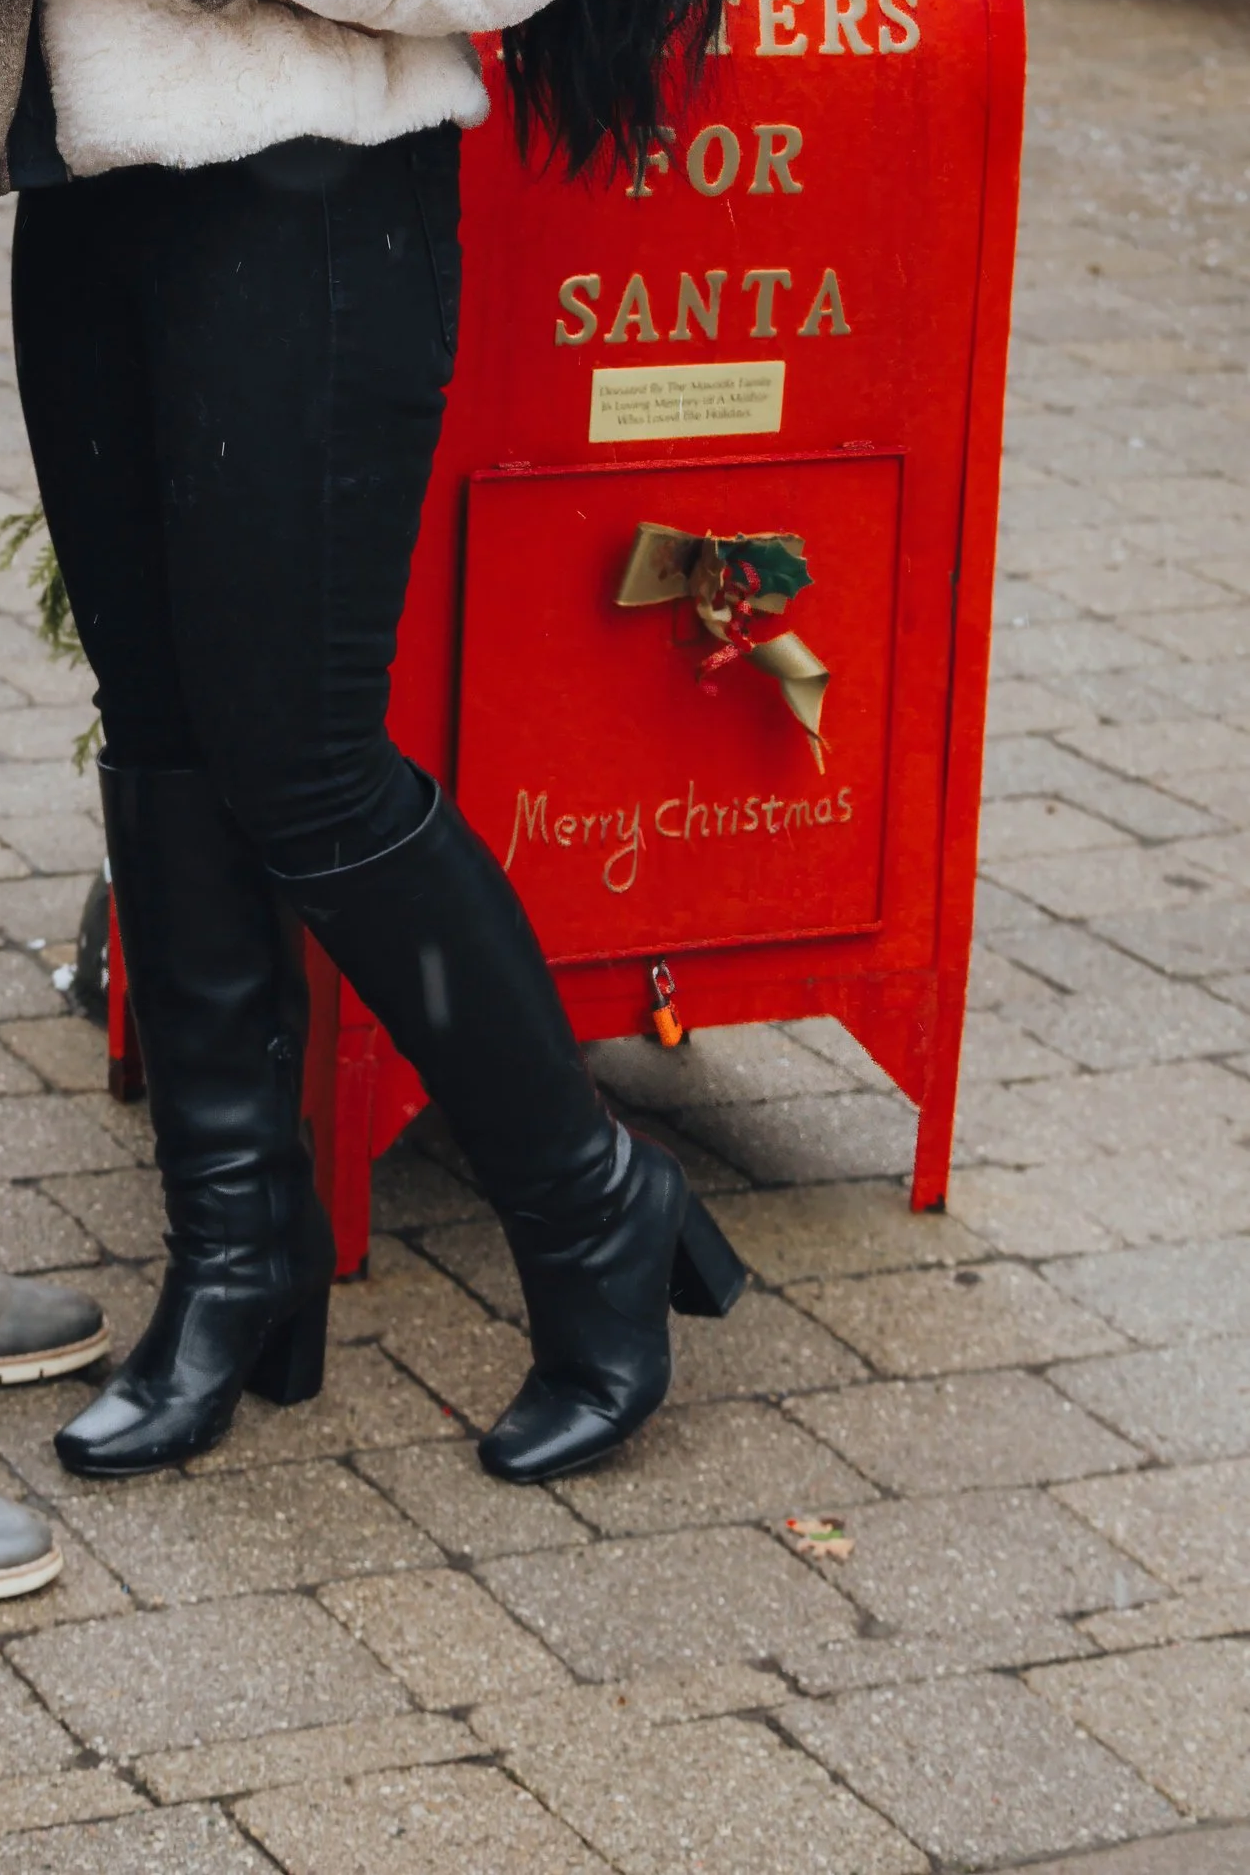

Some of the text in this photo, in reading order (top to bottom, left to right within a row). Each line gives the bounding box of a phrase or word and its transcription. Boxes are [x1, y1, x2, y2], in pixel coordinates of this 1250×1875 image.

[626, 124, 803, 197] FOR
[554, 268, 851, 345] SANTA
[503, 789, 641, 893] Merry
